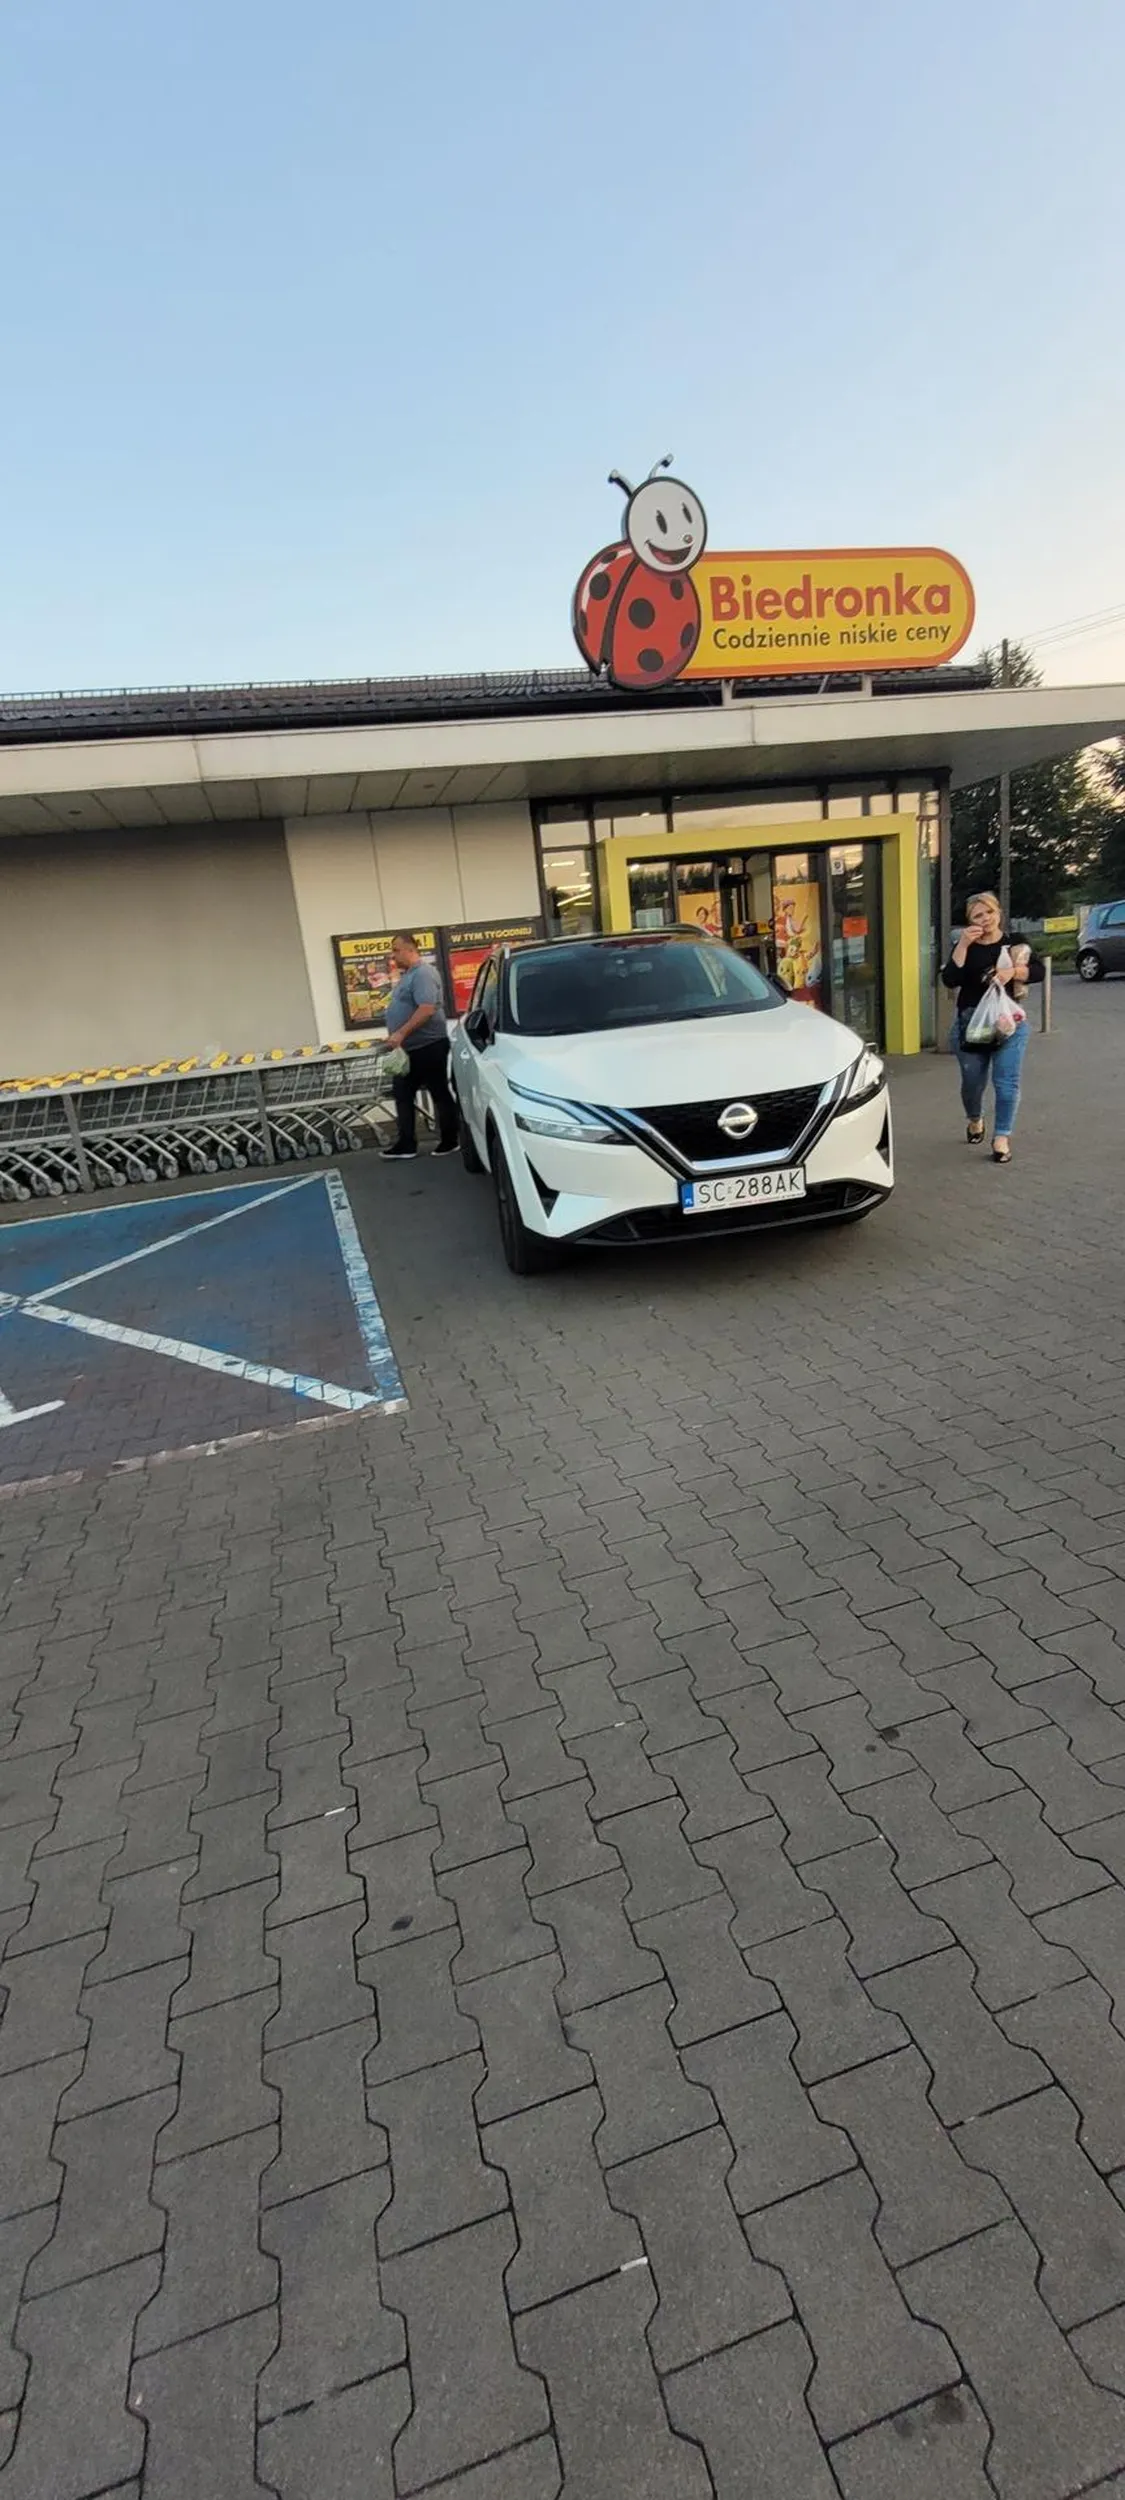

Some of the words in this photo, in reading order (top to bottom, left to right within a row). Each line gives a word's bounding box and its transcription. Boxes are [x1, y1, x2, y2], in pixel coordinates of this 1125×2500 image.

[709, 572, 951, 622] Biedronka
[713, 625, 830, 649] Codziennie
[840, 622, 897, 645] niskie
[906, 624, 951, 643] ceny
[450, 934, 461, 943] W
[463, 931, 483, 941] TYM
[698, 1182, 725, 1203] SC
[735, 1170, 800, 1199] 288AK
